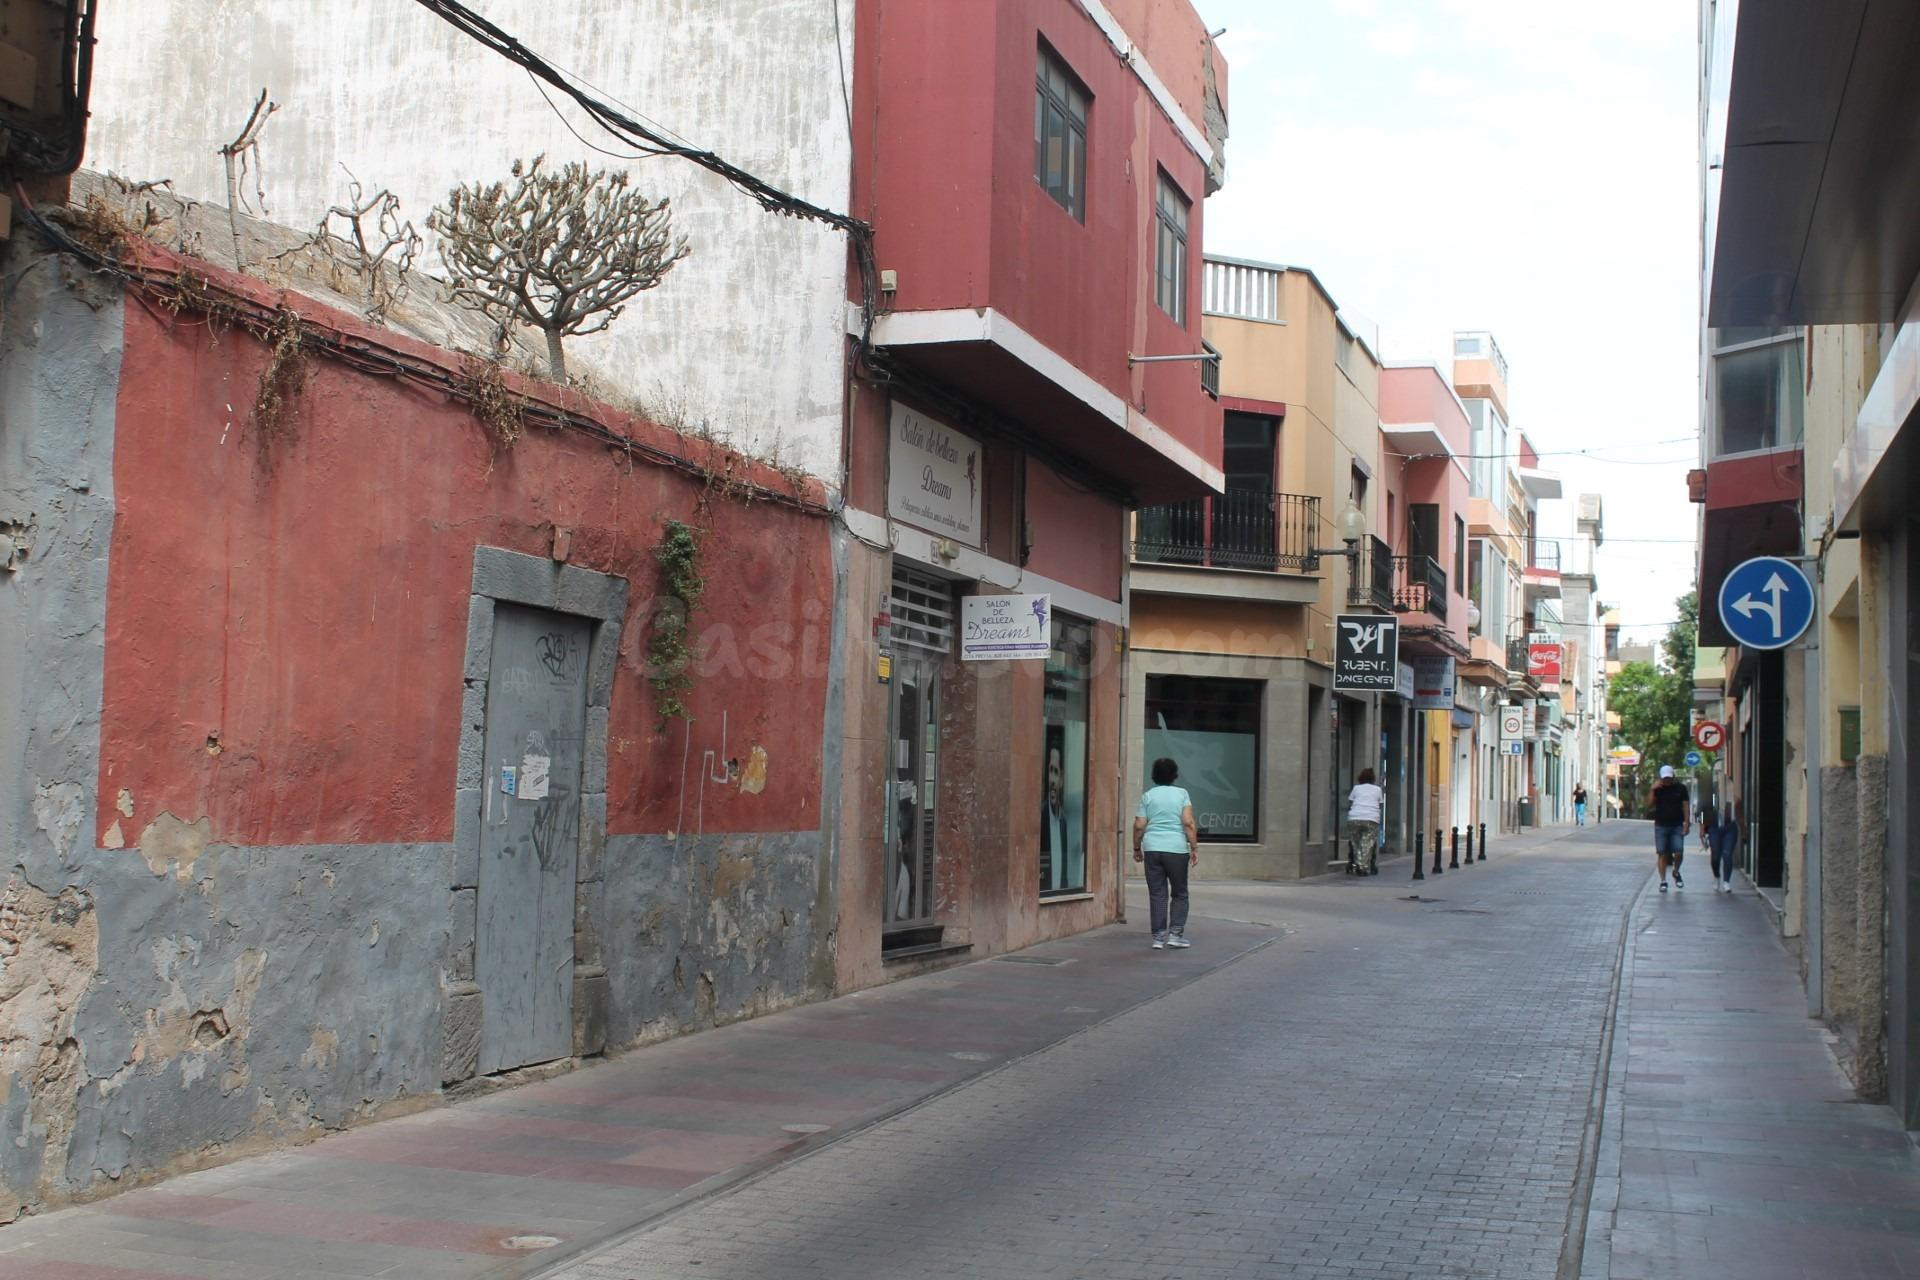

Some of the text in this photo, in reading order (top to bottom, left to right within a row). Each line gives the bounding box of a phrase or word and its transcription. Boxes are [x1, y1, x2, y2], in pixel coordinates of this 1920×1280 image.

[921, 465, 951, 500] Dreams
[966, 621, 1031, 640] Dreams
[1342, 660, 1378, 670] RUBEN
[1336, 675, 1394, 684] DANCE CENTER
[1199, 812, 1248, 828] CENTER
